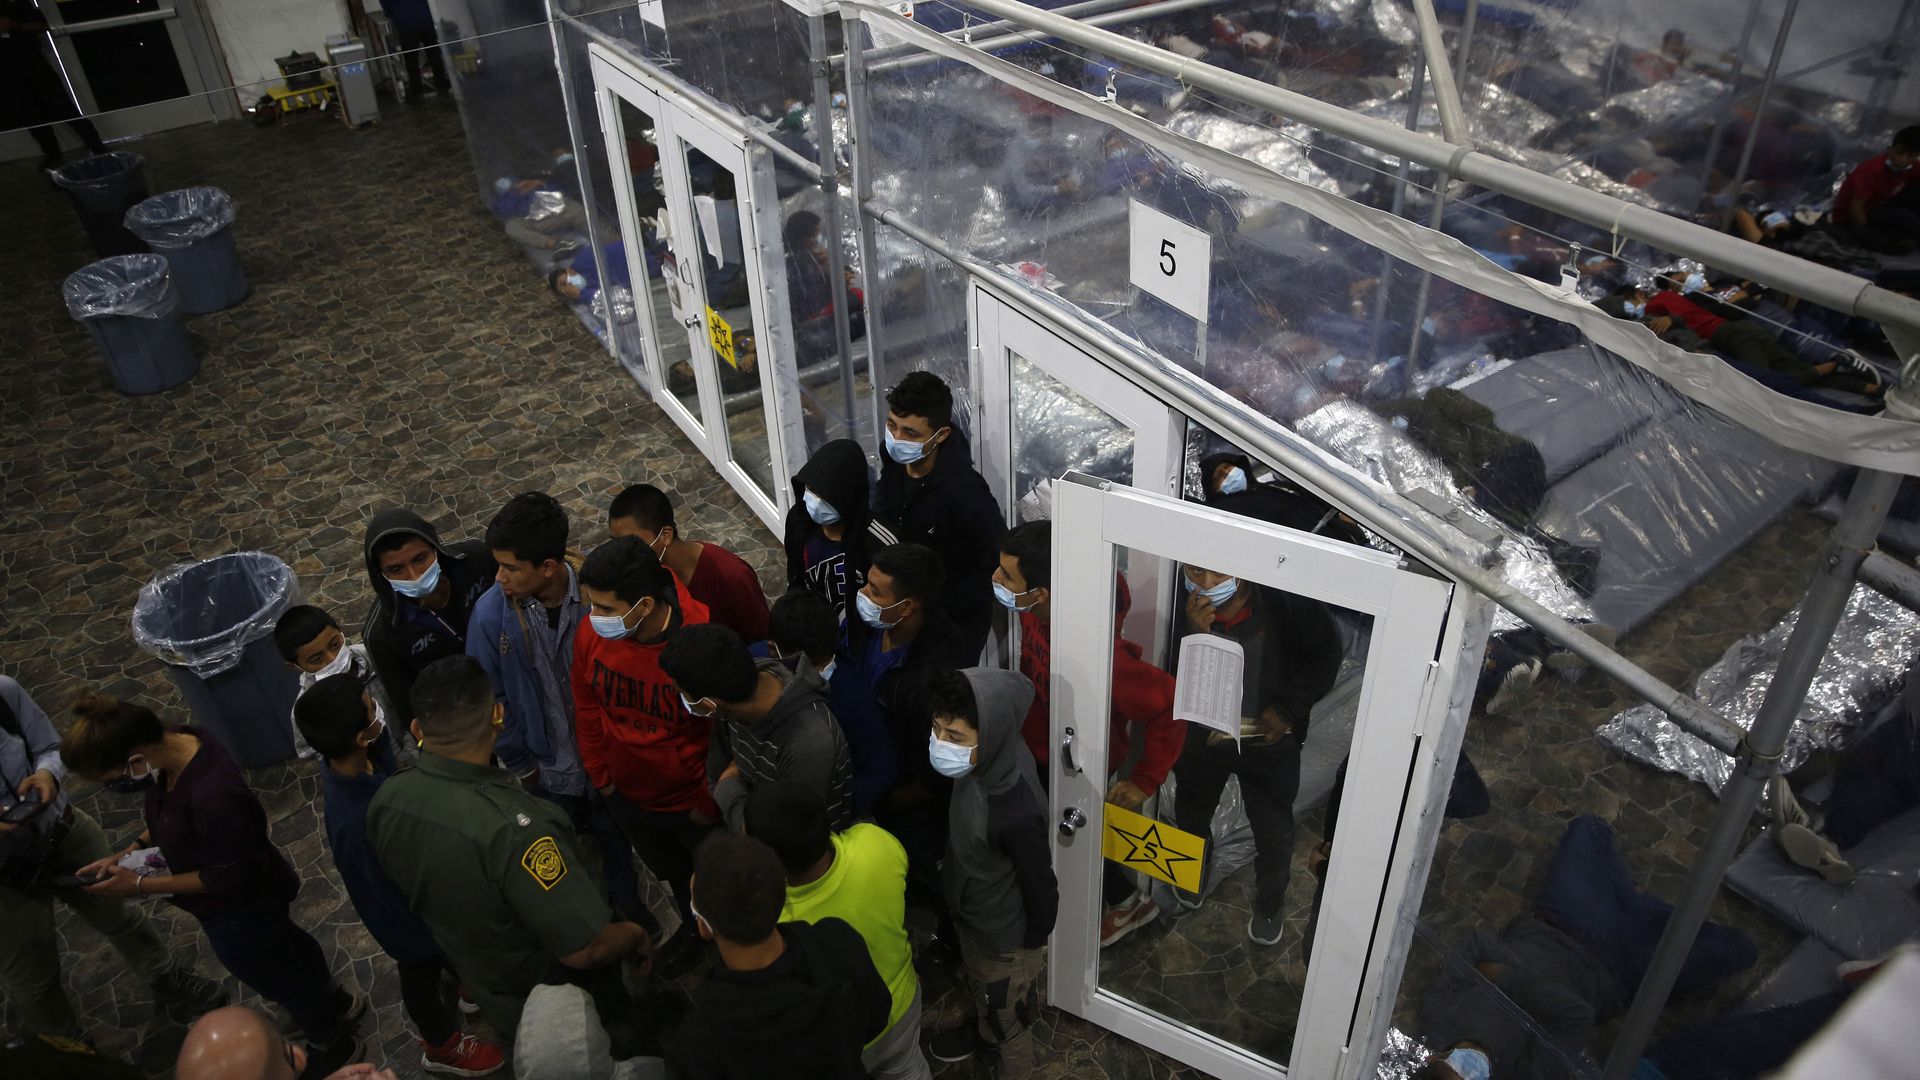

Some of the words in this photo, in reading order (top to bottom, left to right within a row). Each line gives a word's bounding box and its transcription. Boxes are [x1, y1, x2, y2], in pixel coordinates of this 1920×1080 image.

[1159, 238, 1177, 277] 5
[606, 706, 674, 737] PORT
[1143, 841, 1159, 860] 5
